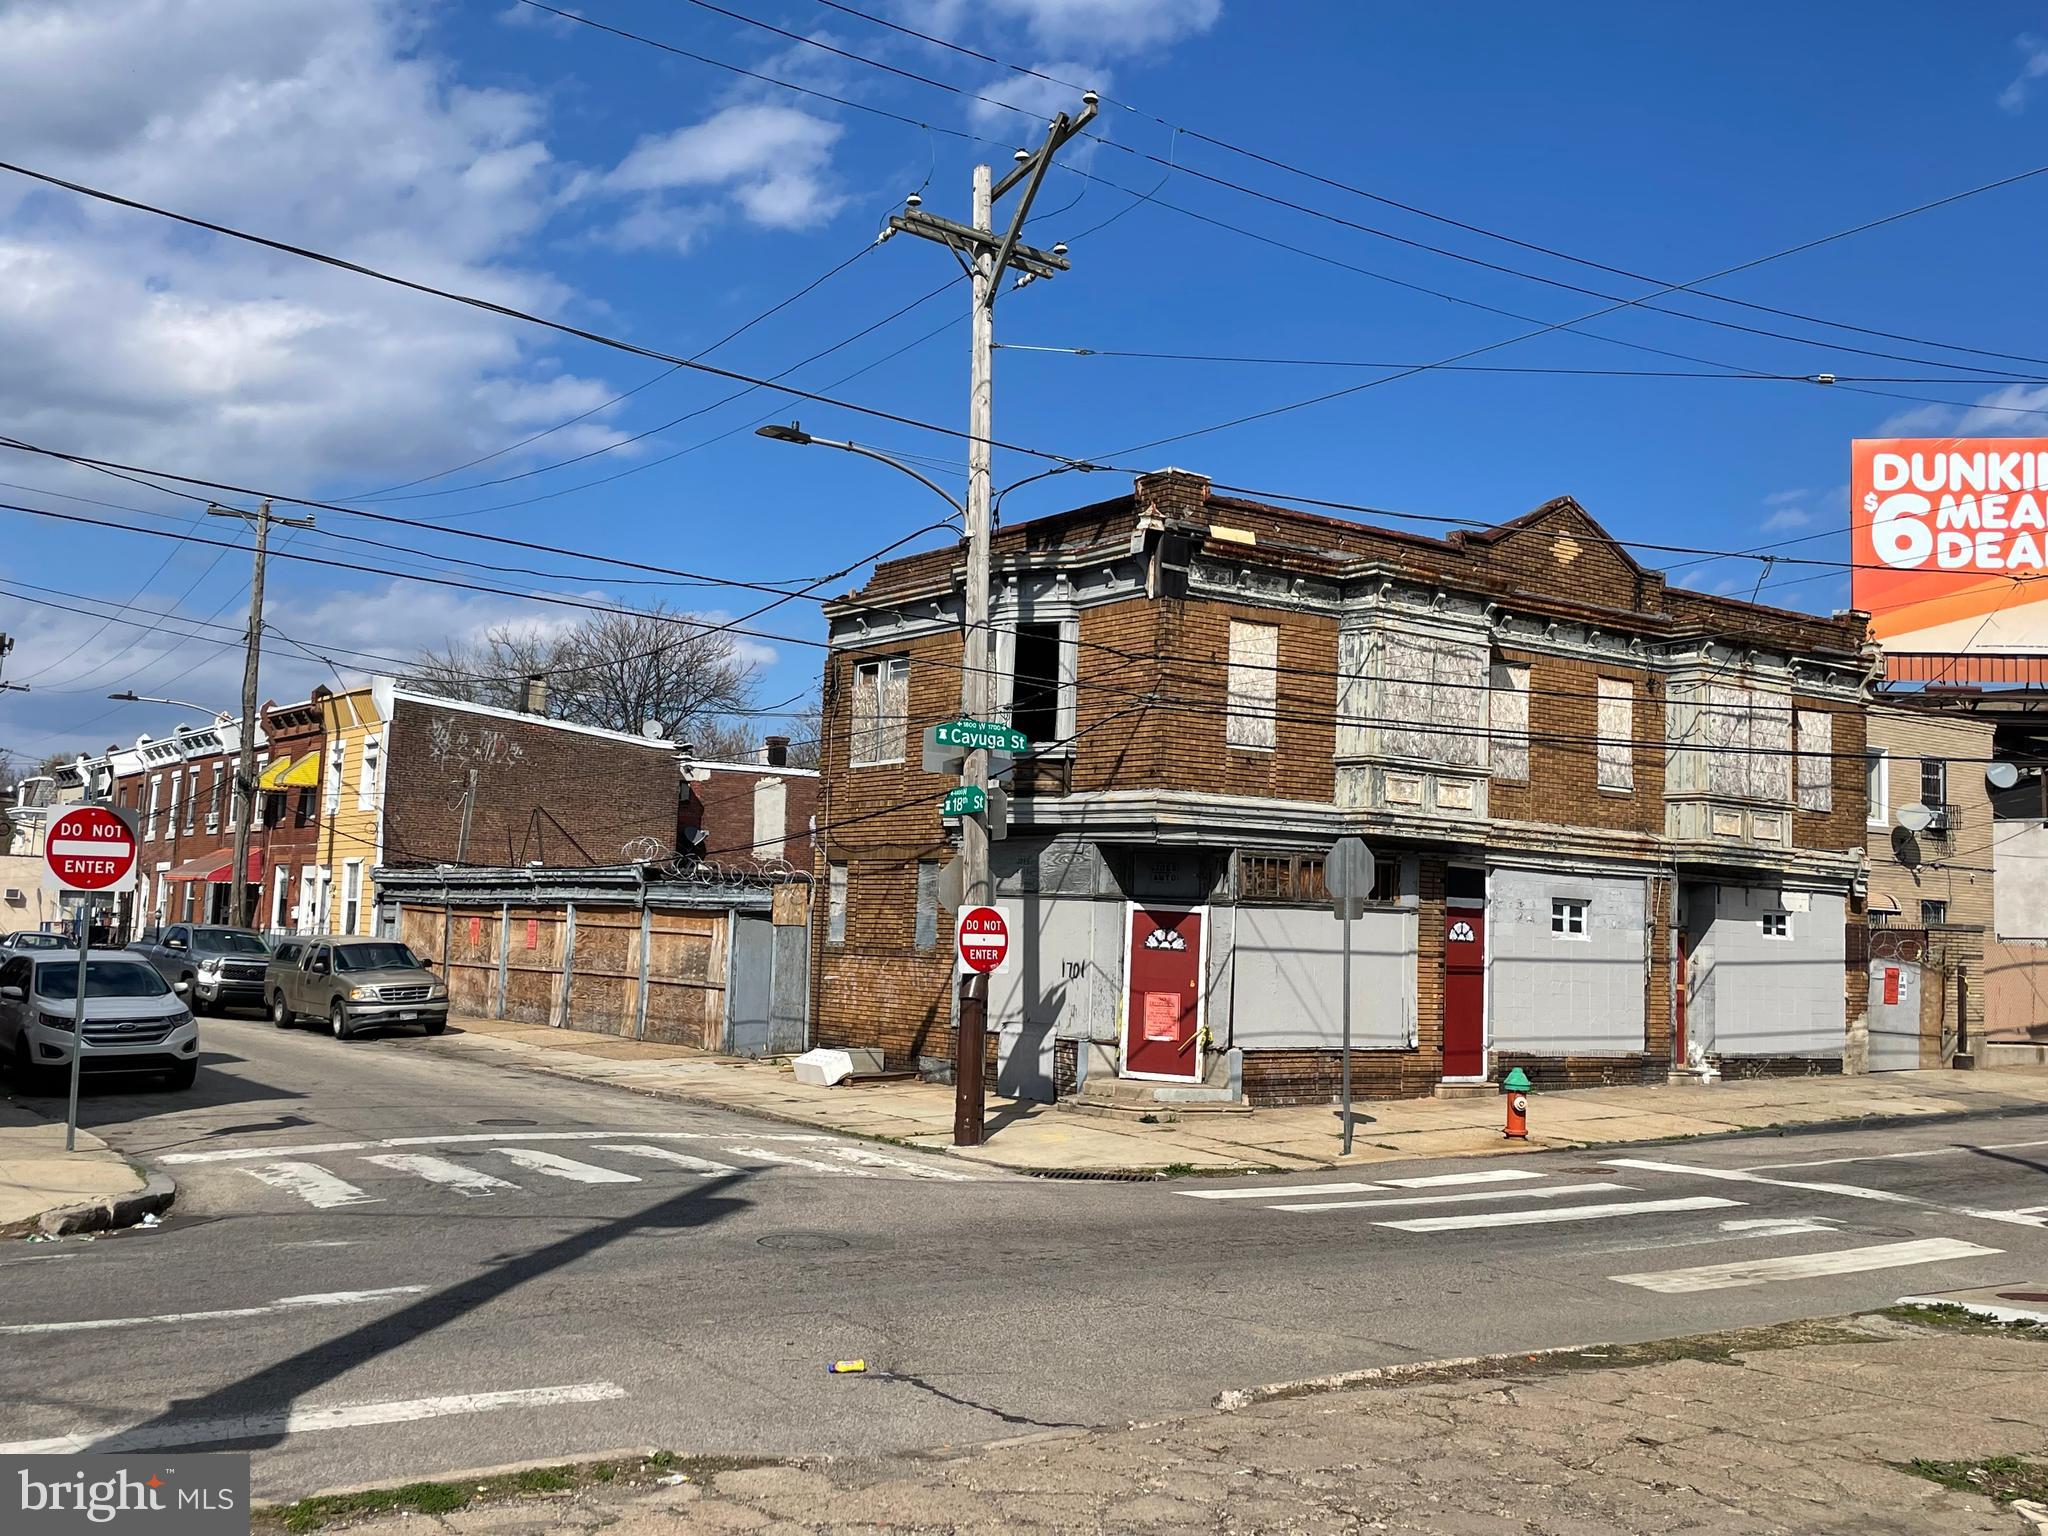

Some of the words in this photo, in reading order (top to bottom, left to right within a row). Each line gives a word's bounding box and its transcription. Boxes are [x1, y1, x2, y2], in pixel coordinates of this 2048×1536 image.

[1936, 494, 2048, 529] MEA
[1863, 491, 1934, 569] $6
[1937, 531, 2048, 569] DEA
[963, 721, 977, 729] 1800
[978, 722, 986, 731] W
[951, 728, 1005, 749] Cayuga
[1011, 735, 1025, 750] St
[974, 795, 984, 809] St
[61, 823, 83, 836] DO
[92, 824, 123, 838] NOT
[64, 860, 115, 874] ENTER
[966, 920, 979, 931] DO
[983, 920, 1002, 931] NOT
[969, 949, 998, 960] ENTER
[1061, 958, 1085, 979] 1701
